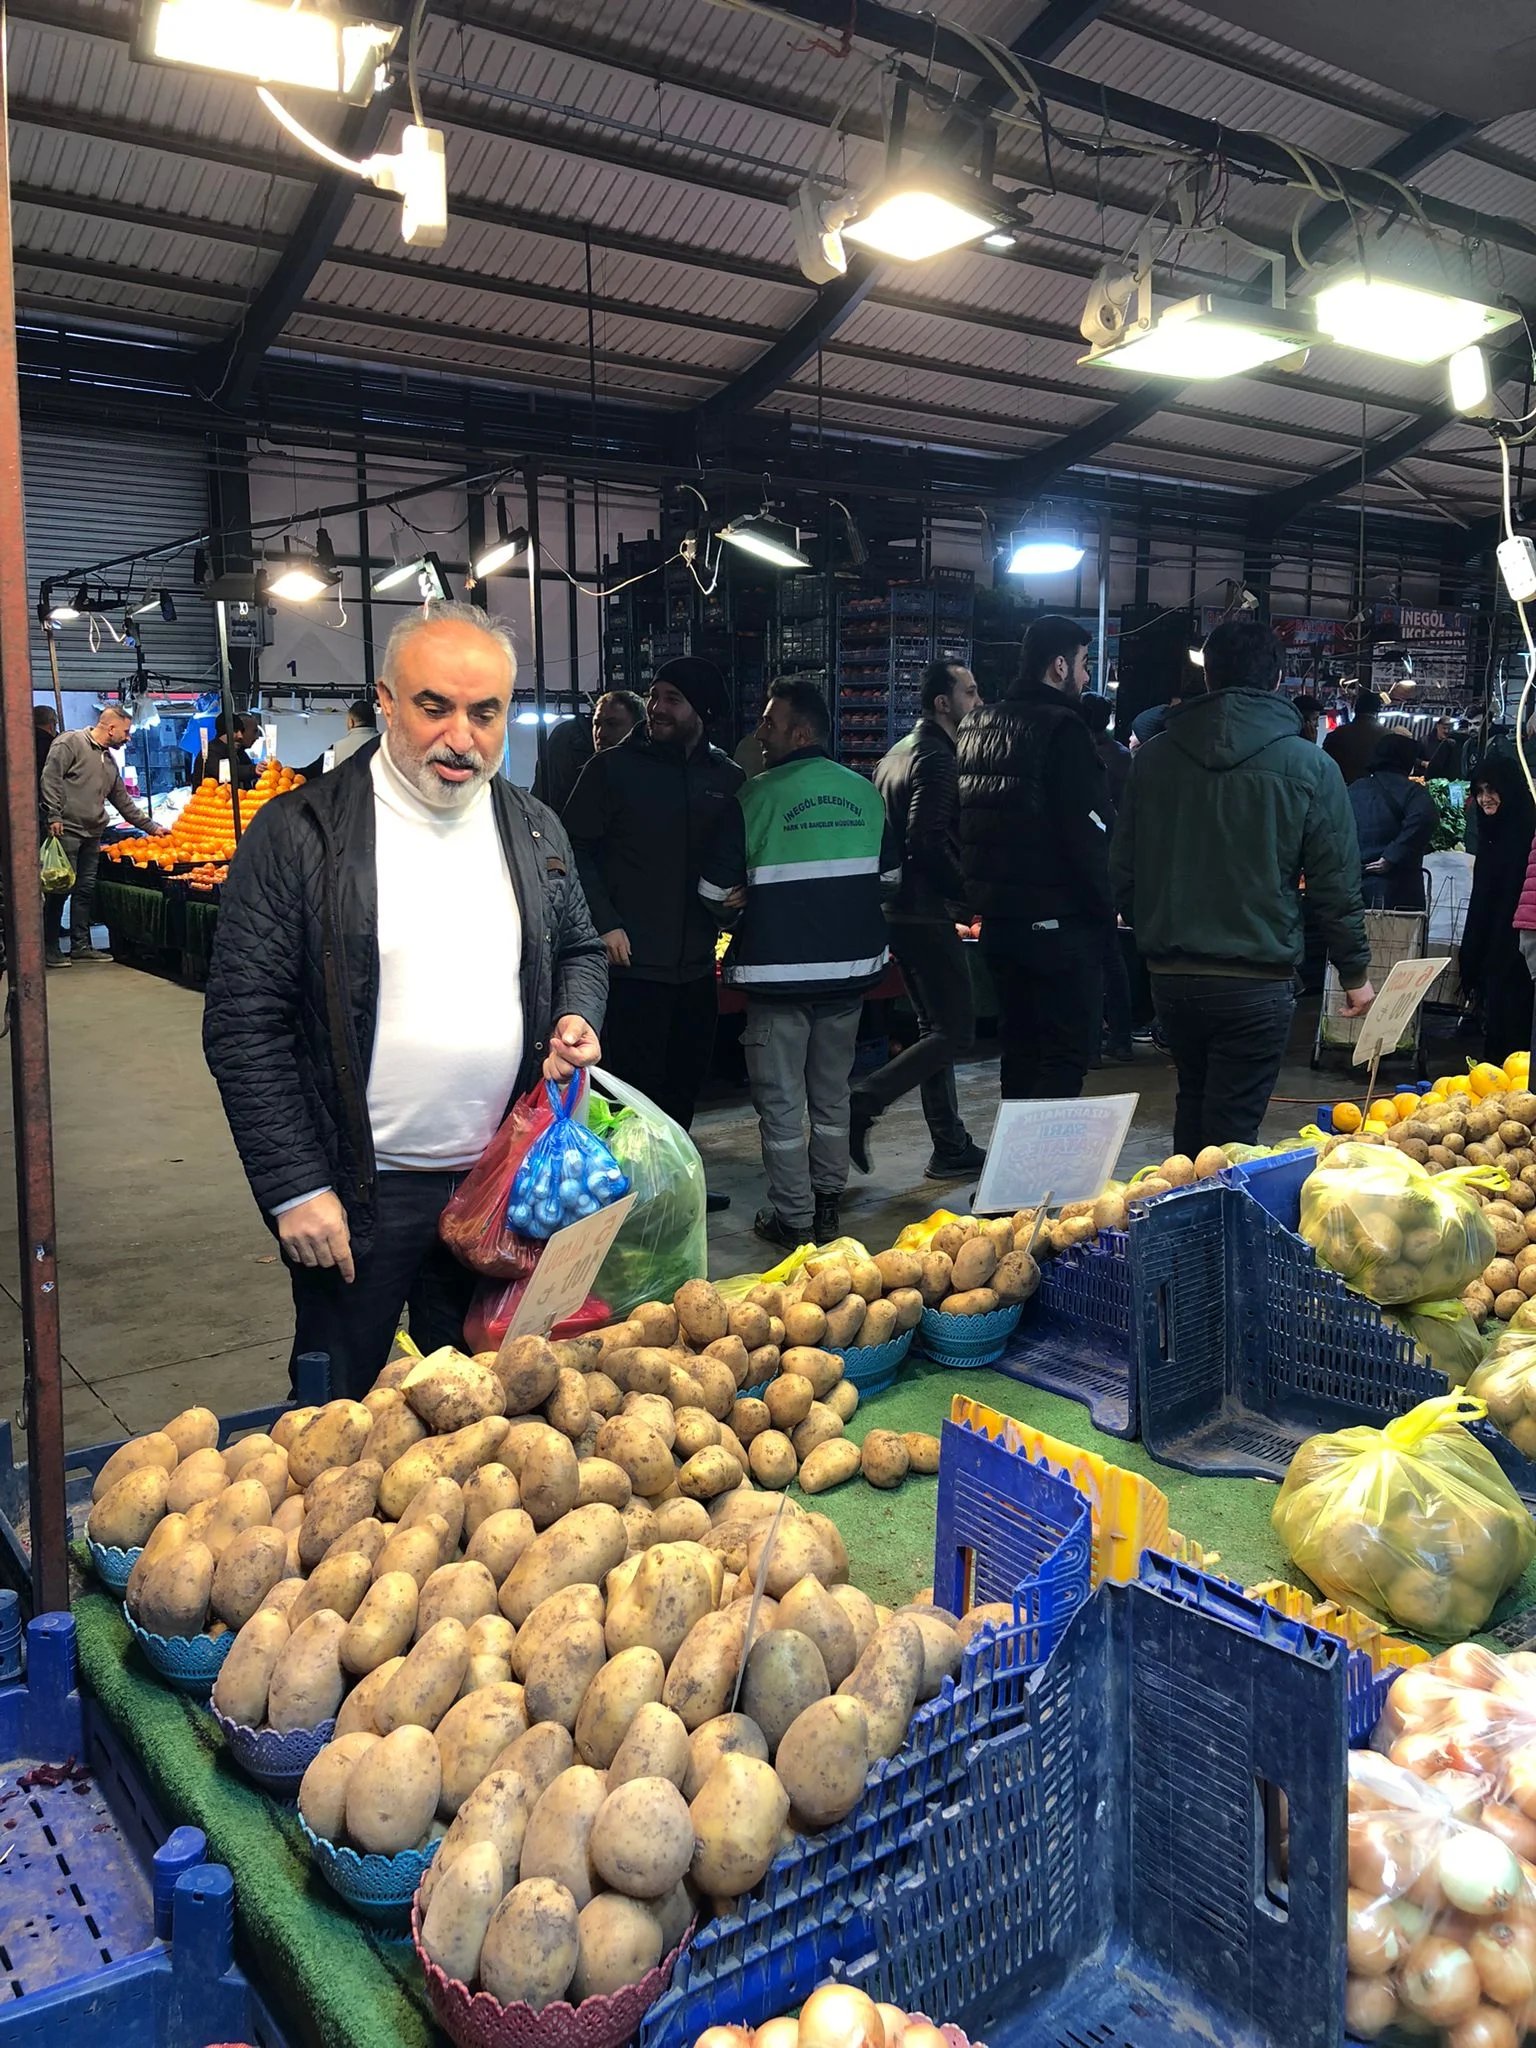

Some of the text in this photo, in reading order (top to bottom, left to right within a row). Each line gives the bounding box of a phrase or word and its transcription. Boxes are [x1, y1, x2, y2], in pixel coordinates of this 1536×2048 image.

[1400, 607, 1445, 627] İNEGÖL
[286, 660, 297, 677] 1
[783, 795, 862, 823] İNEGÖL BELEDİYESİ
[783, 824, 799, 832] PARK
[800, 822, 808, 830] VE
